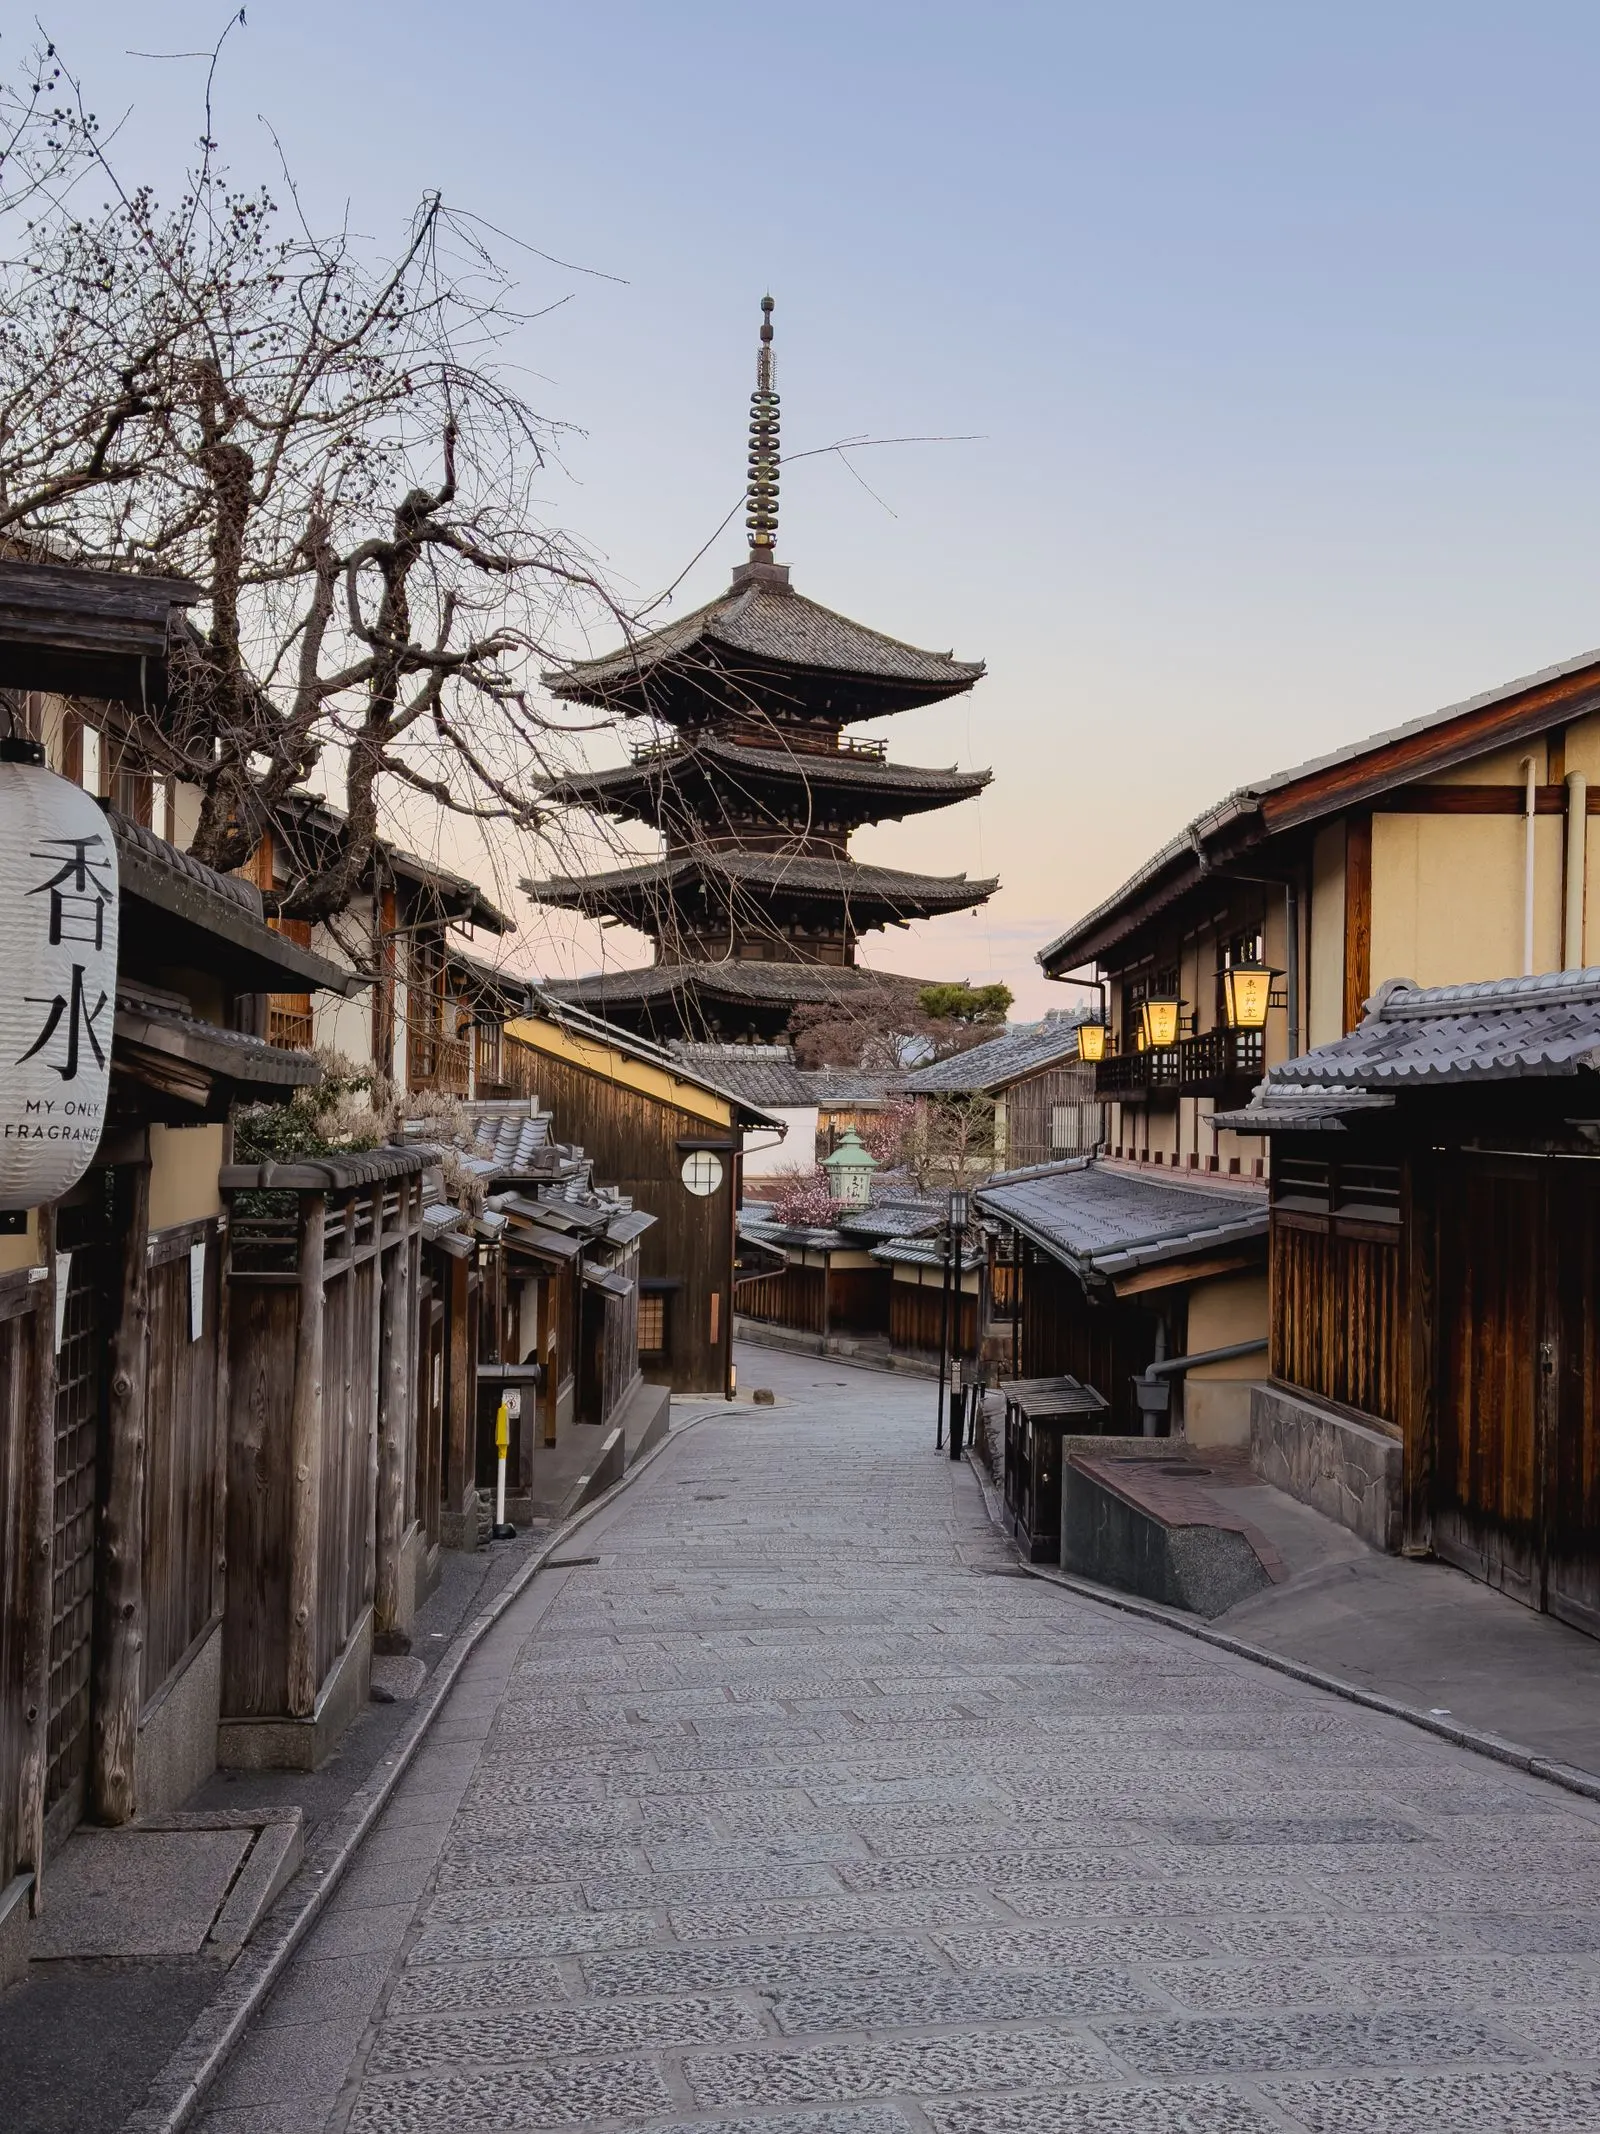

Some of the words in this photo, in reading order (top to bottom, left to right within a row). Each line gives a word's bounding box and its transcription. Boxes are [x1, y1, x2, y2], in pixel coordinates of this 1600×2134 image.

[15, 834, 114, 1081] 香水
[25, 1099, 55, 1114] MY
[64, 1101, 100, 1117] ONLY
